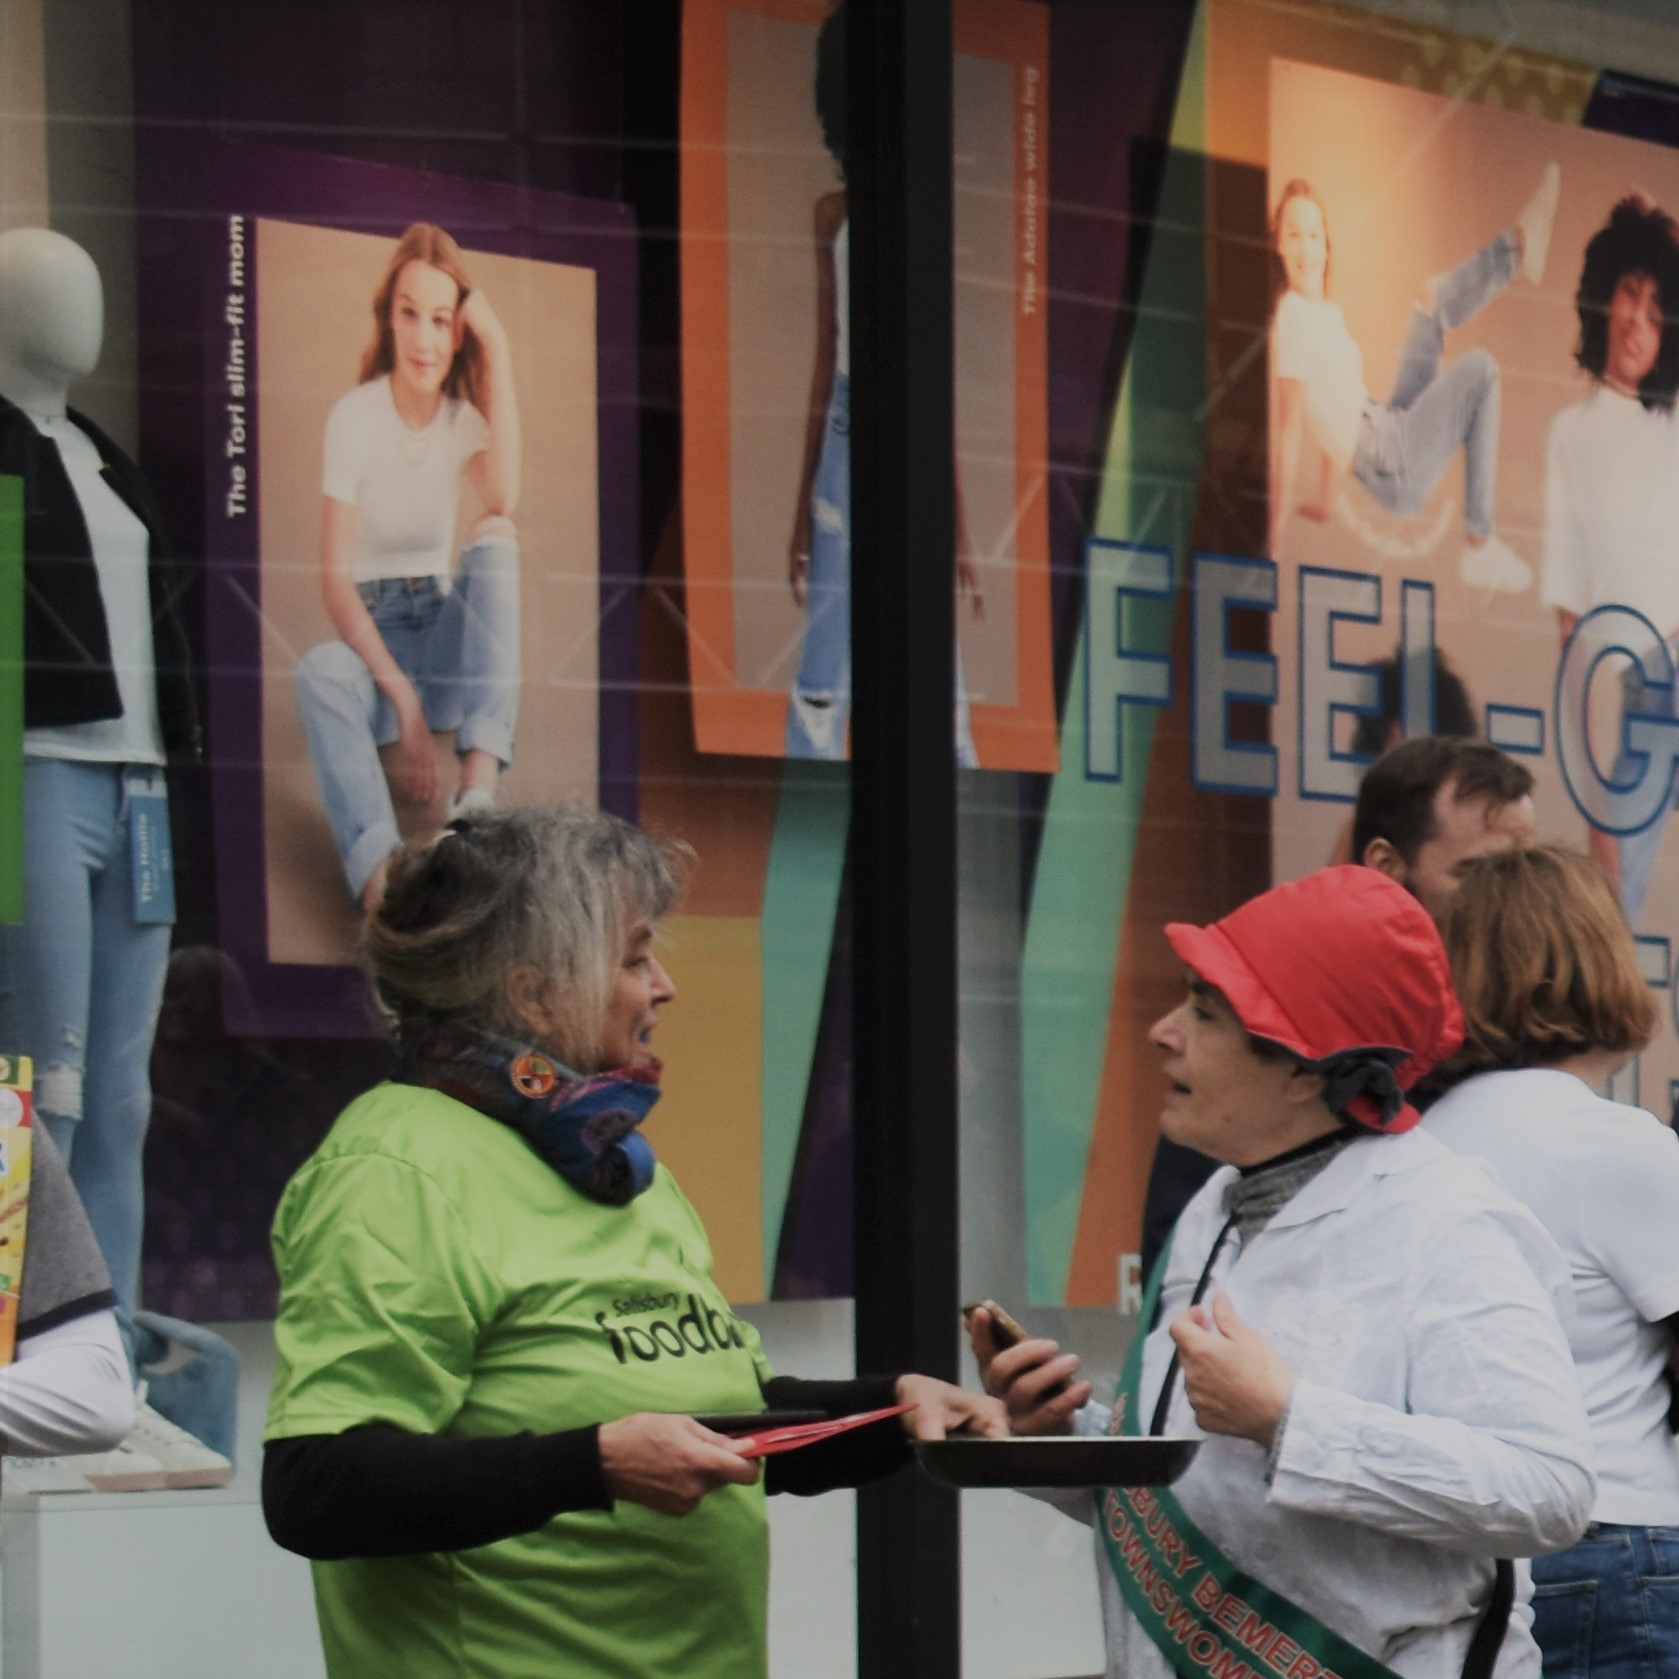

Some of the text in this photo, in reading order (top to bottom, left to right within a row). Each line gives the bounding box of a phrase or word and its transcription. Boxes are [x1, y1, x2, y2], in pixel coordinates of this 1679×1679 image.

[229, 215, 245, 287] mom
[225, 294, 246, 398] slim-fit
[226, 465, 247, 518] The
